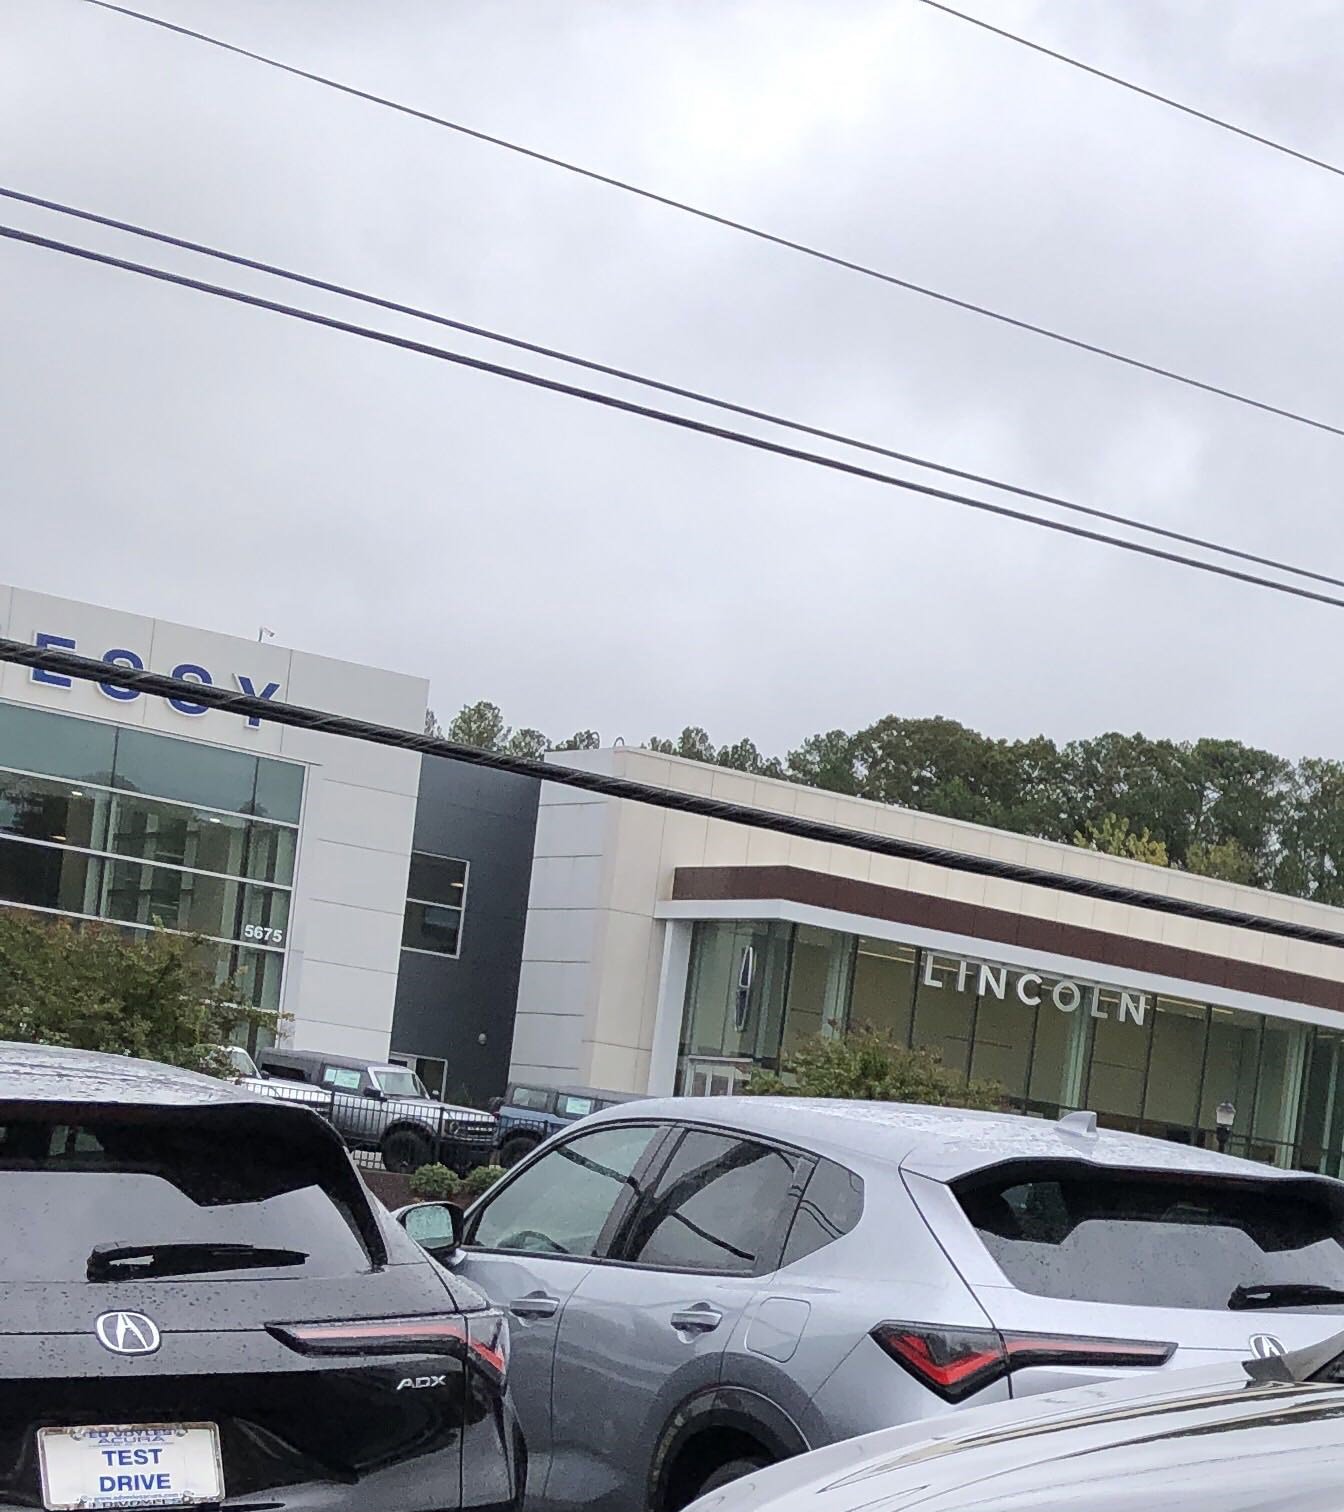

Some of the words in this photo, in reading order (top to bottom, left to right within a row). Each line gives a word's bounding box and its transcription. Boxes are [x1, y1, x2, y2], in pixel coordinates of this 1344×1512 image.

[244, 924, 283, 943] 5675
[924, 953, 1146, 1026] LINCOLN
[396, 1375, 447, 1390] ADX
[101, 1448, 163, 1466] TEST
[100, 1473, 172, 1492] DRIVE
